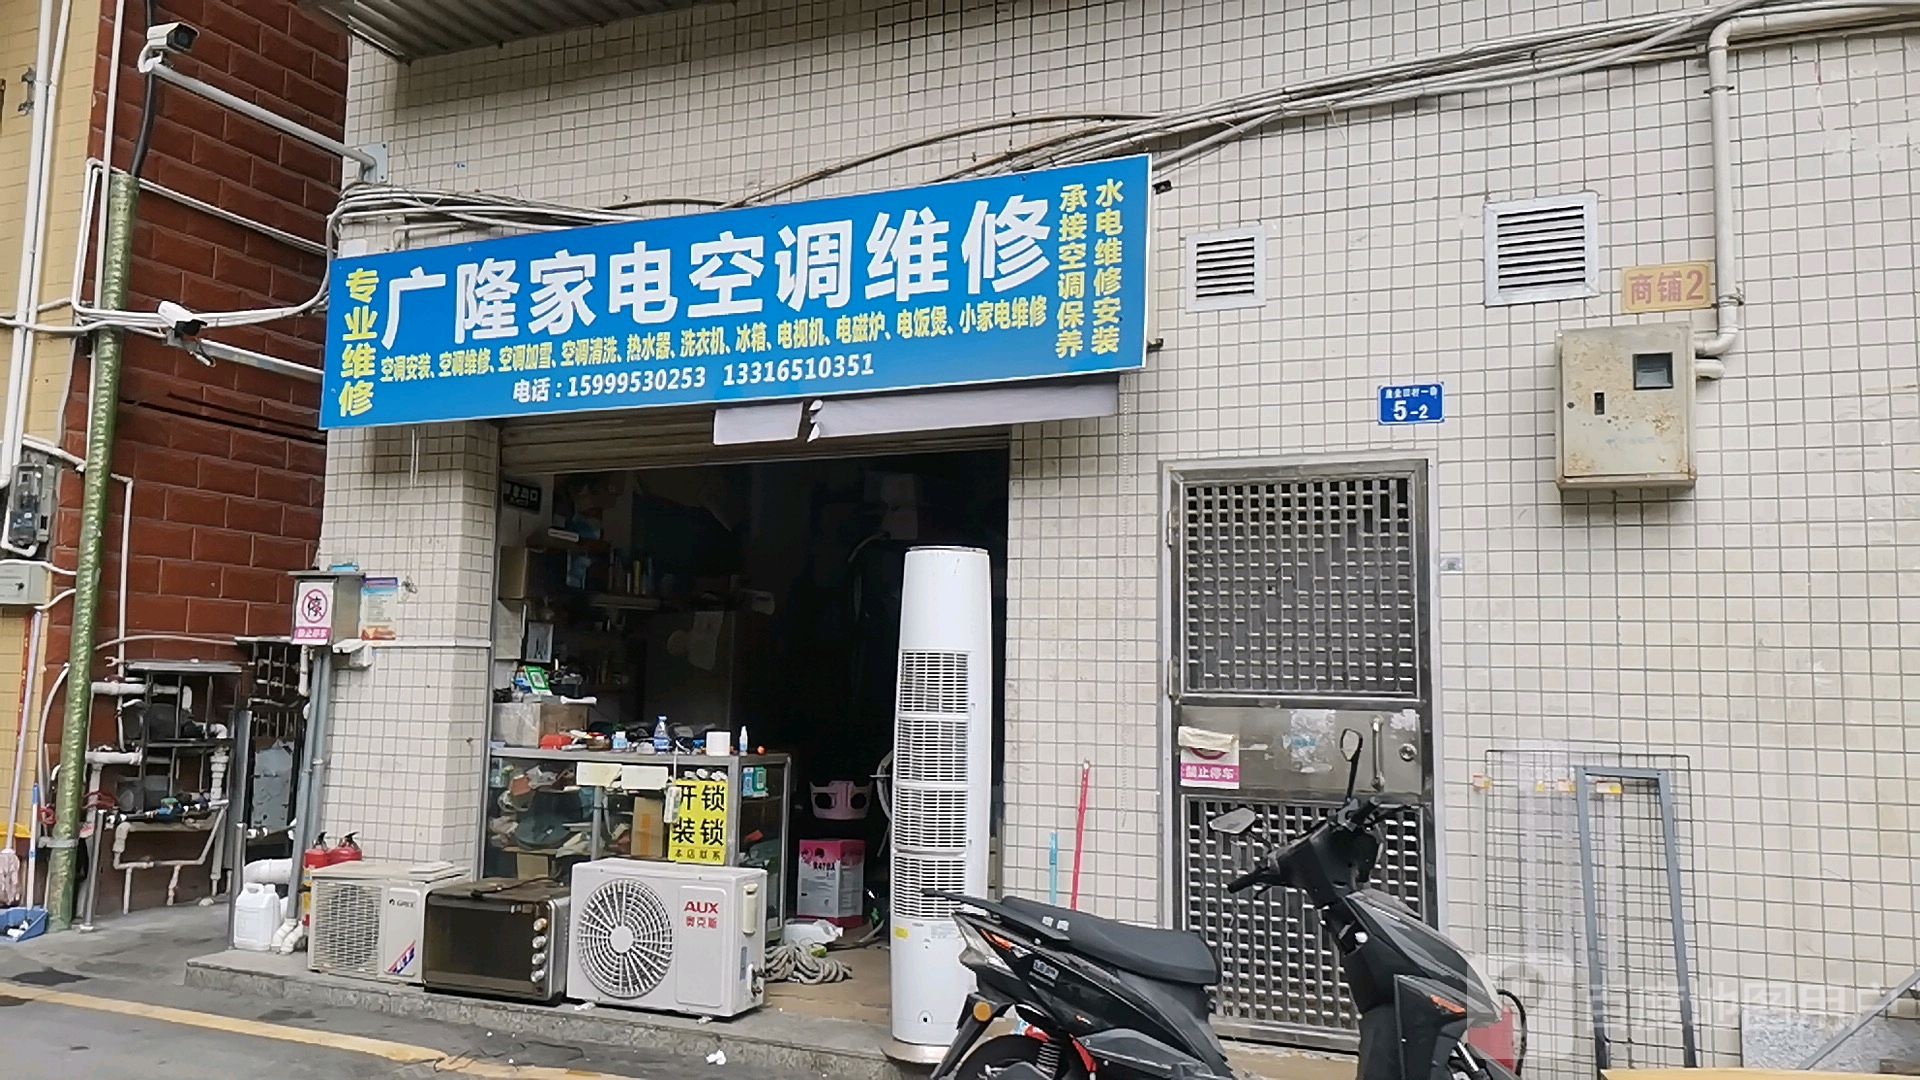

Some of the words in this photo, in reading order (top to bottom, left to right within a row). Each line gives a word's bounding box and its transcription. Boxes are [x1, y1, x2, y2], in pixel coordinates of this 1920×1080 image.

[382, 194, 1051, 350] 广隆家电空调维修
[1056, 184, 1087, 358] 承接空调保养
[1092, 178, 1124, 355] 水电维修安装
[1629, 270, 1705, 306] 商铺2
[338, 267, 379, 418] 专业维修
[723, 353, 873, 386] 13316510351
[1393, 400, 1429, 421] 5-2
[675, 784, 725, 812] 开锁
[672, 816, 724, 847] 装锁
[684, 901, 718, 914] AUX
[686, 915, 717, 929] 奥克斯
